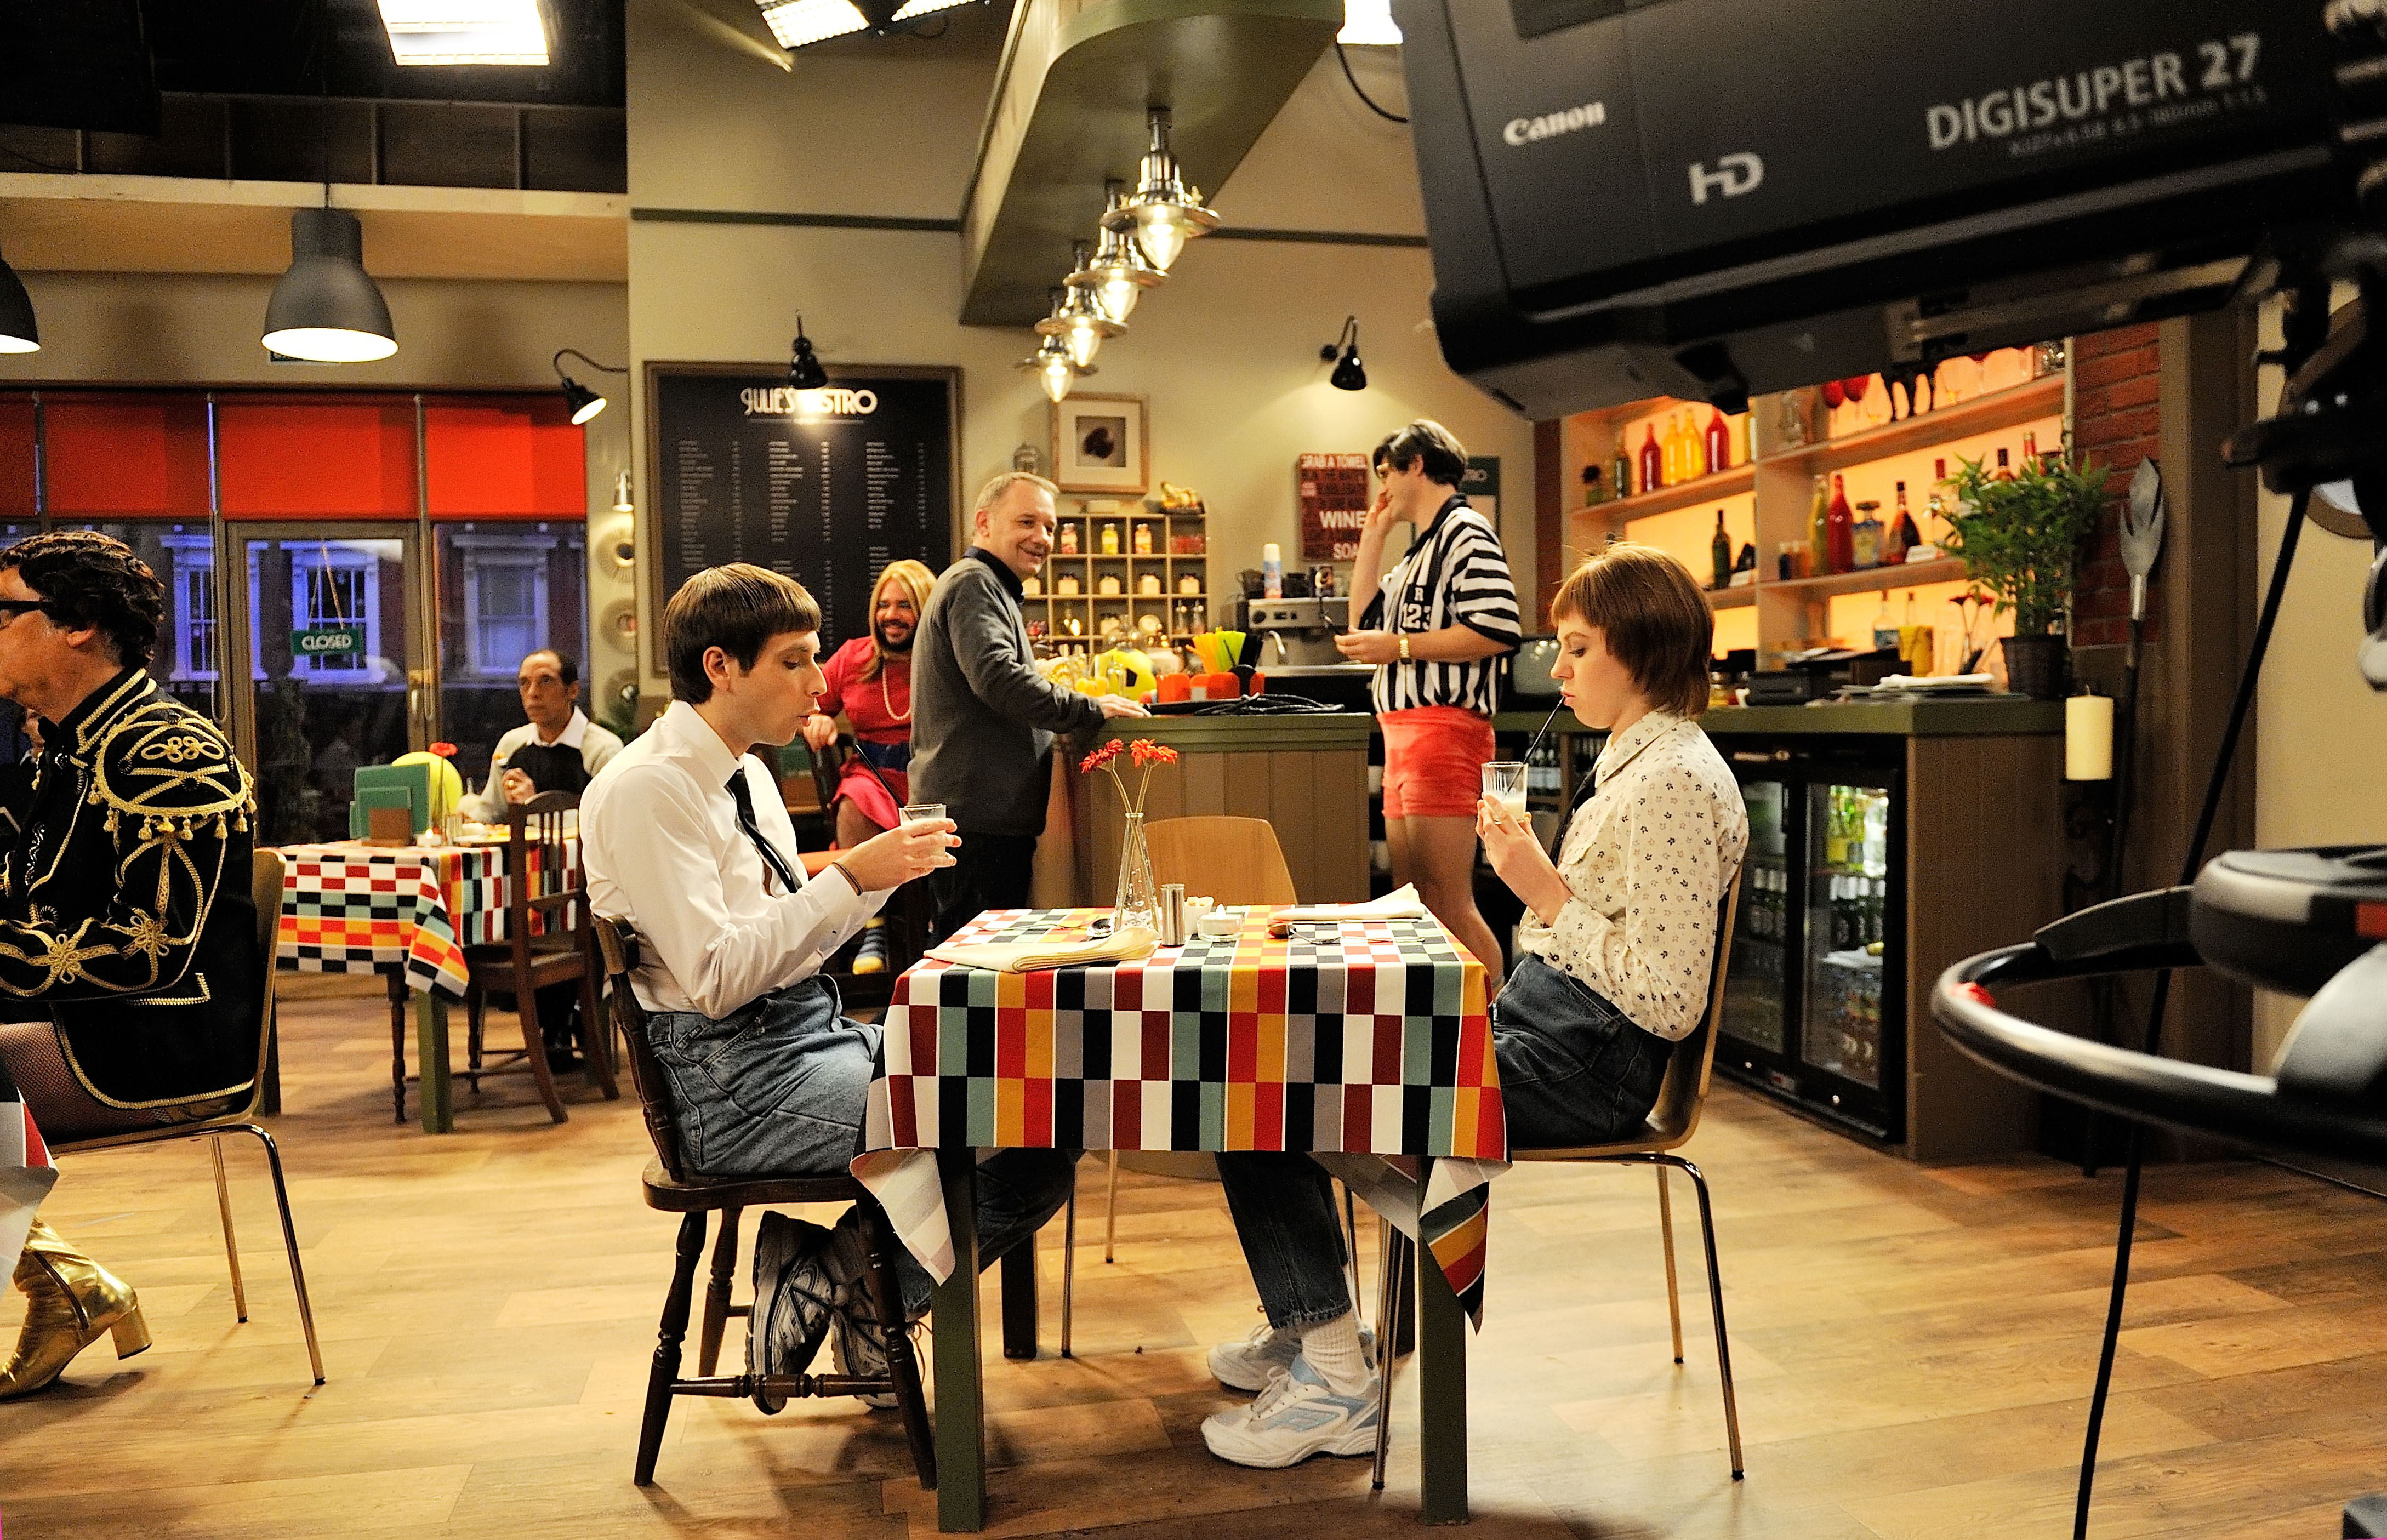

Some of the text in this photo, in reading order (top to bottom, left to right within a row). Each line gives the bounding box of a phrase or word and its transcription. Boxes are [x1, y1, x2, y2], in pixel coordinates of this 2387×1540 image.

[1926, 50, 2187, 150] DIGISUPER
[2198, 32, 2261, 89] 27
[1503, 101, 1606, 146] Canon
[1689, 152, 1764, 205] HD
[797, 388, 878, 414] STRO
[1319, 510, 1367, 529] WINE
[301, 634, 354, 651] CLOSED
